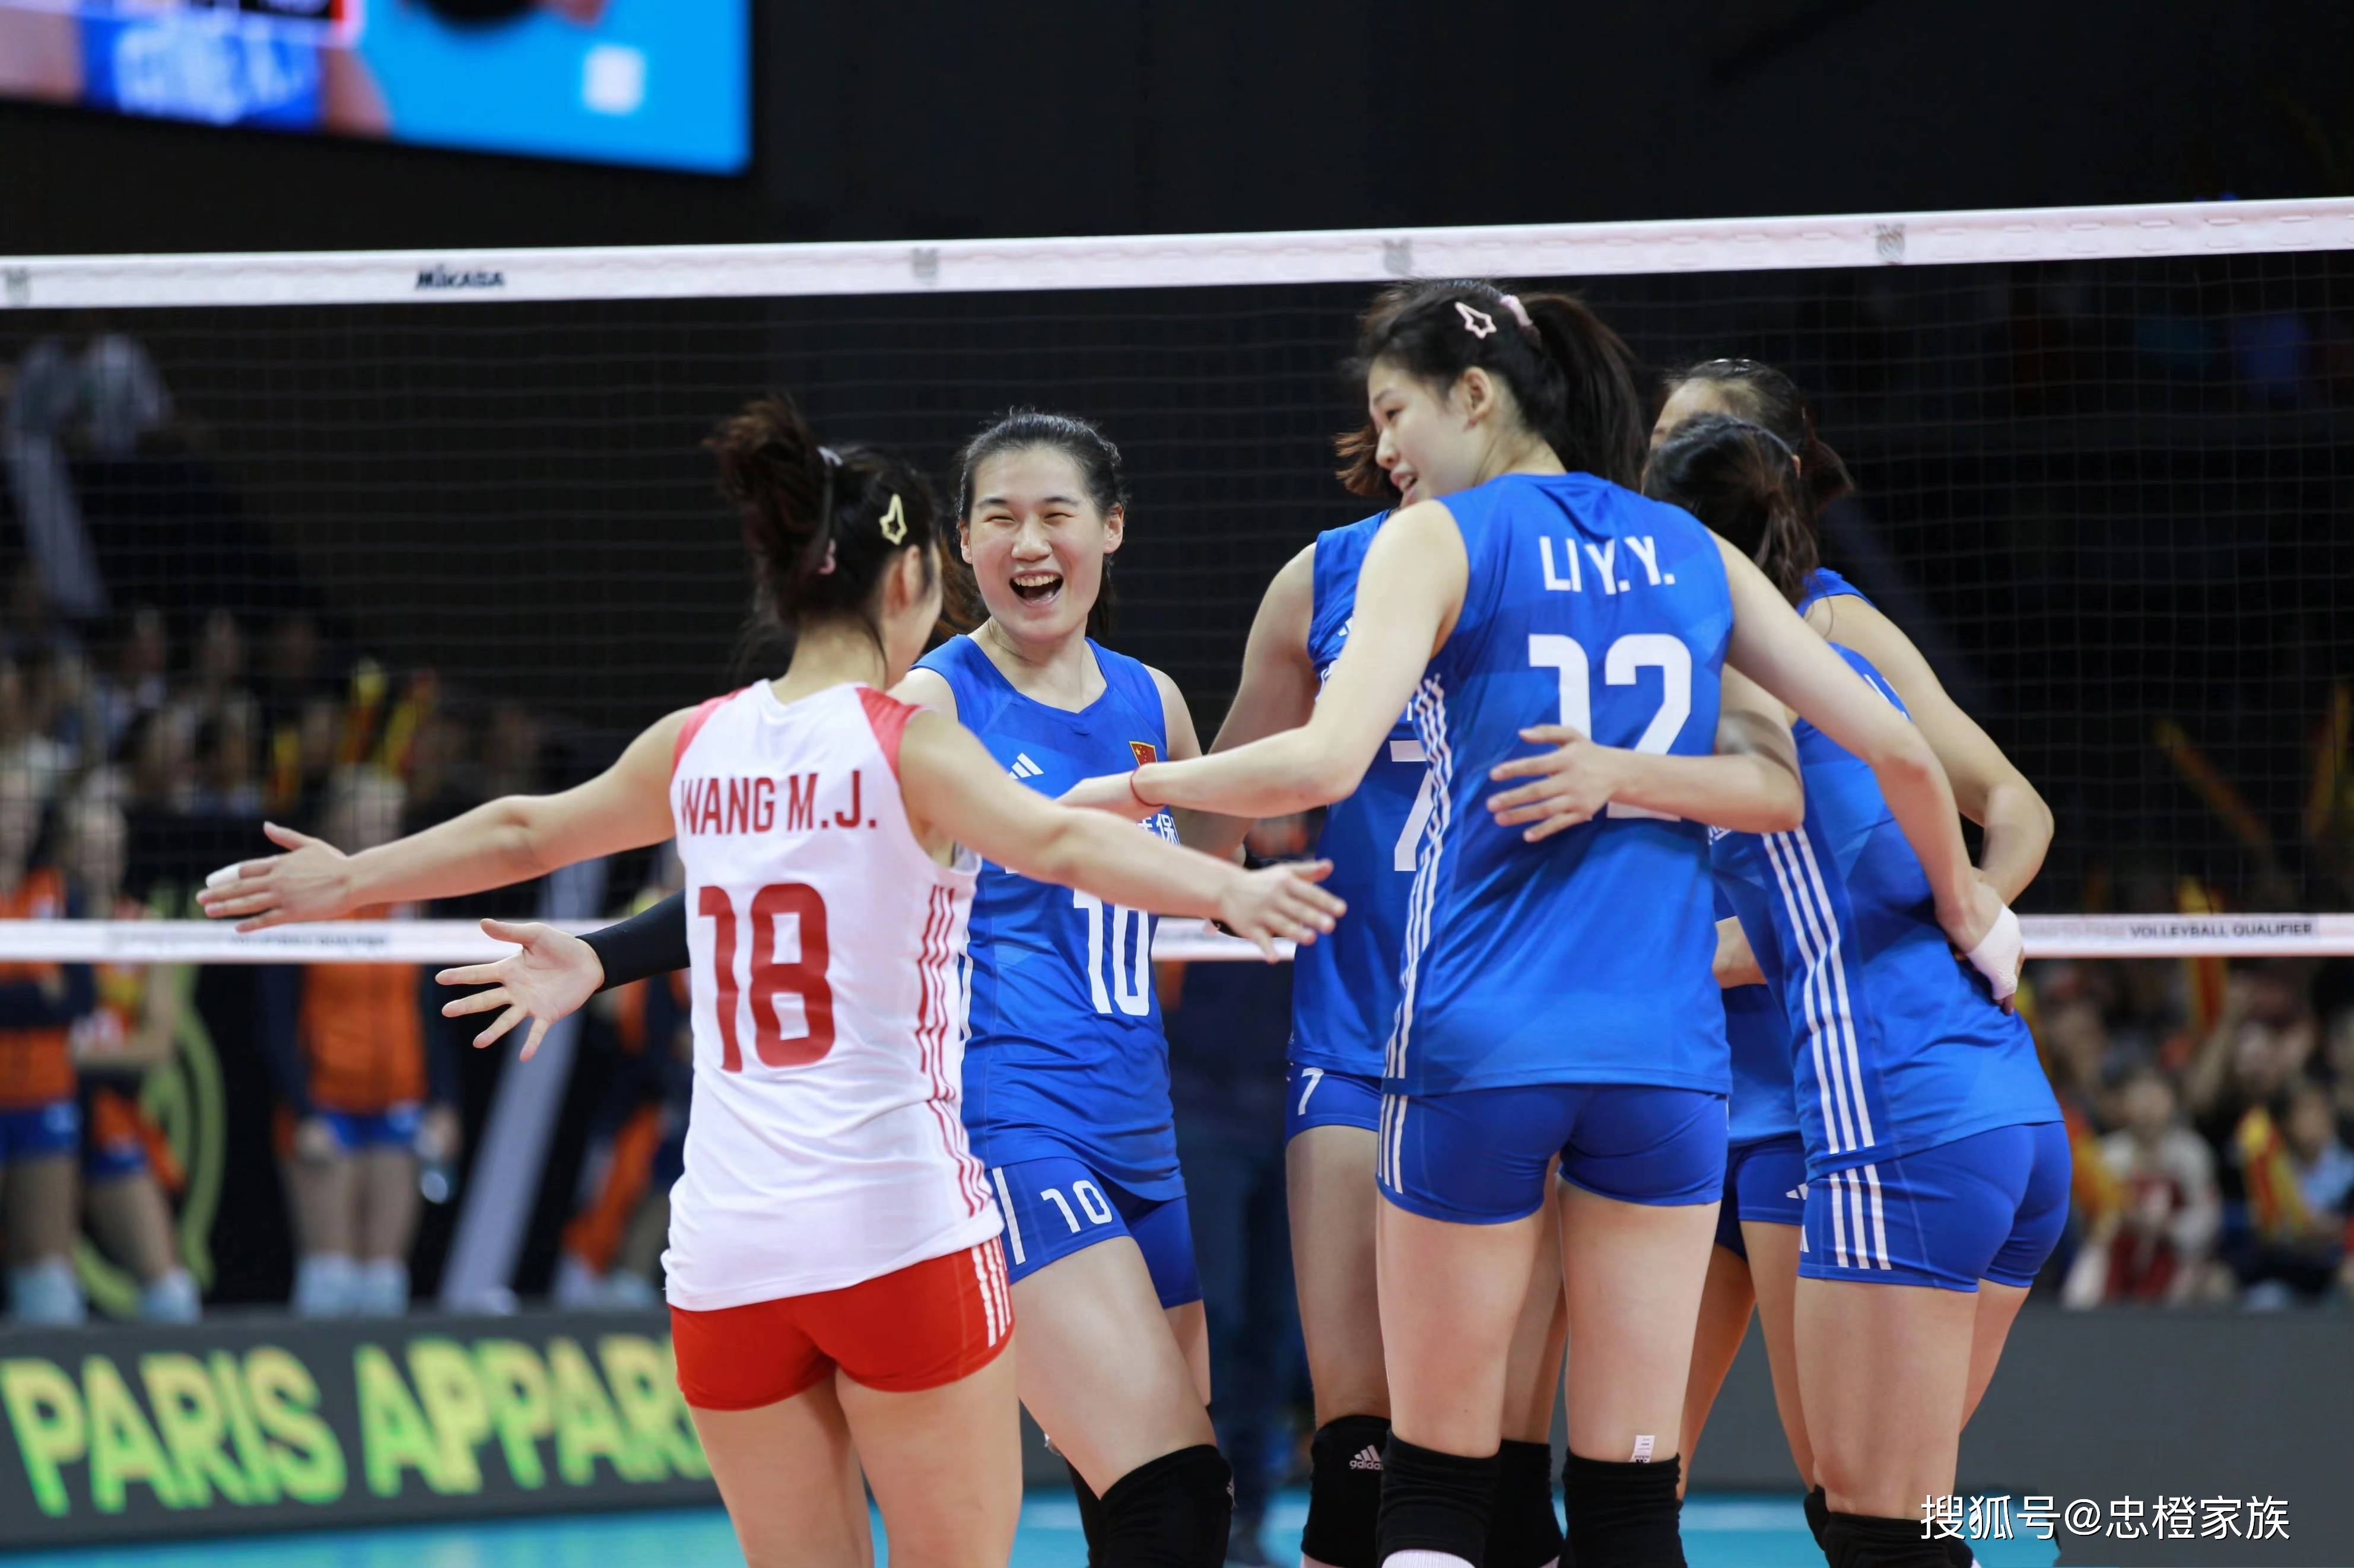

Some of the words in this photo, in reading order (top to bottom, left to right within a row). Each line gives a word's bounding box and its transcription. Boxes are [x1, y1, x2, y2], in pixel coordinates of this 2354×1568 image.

[1539, 536, 1582, 592] LI
[1584, 536, 1676, 595] Y.Y.
[1529, 633, 1691, 822] 12
[681, 777, 775, 835] WANG
[787, 770, 876, 831] M.J.
[1073, 888, 1150, 1017] 10
[2131, 924, 2228, 938] VOLLEYBALL
[2233, 923, 2312, 937] QUALIFIER
[698, 883, 836, 1073] 18
[1298, 1067, 1324, 1115] 7
[1040, 1179, 1113, 1233] 10
[1, 1346, 348, 1516] PARIS
[353, 1334, 713, 1496] APPAR
